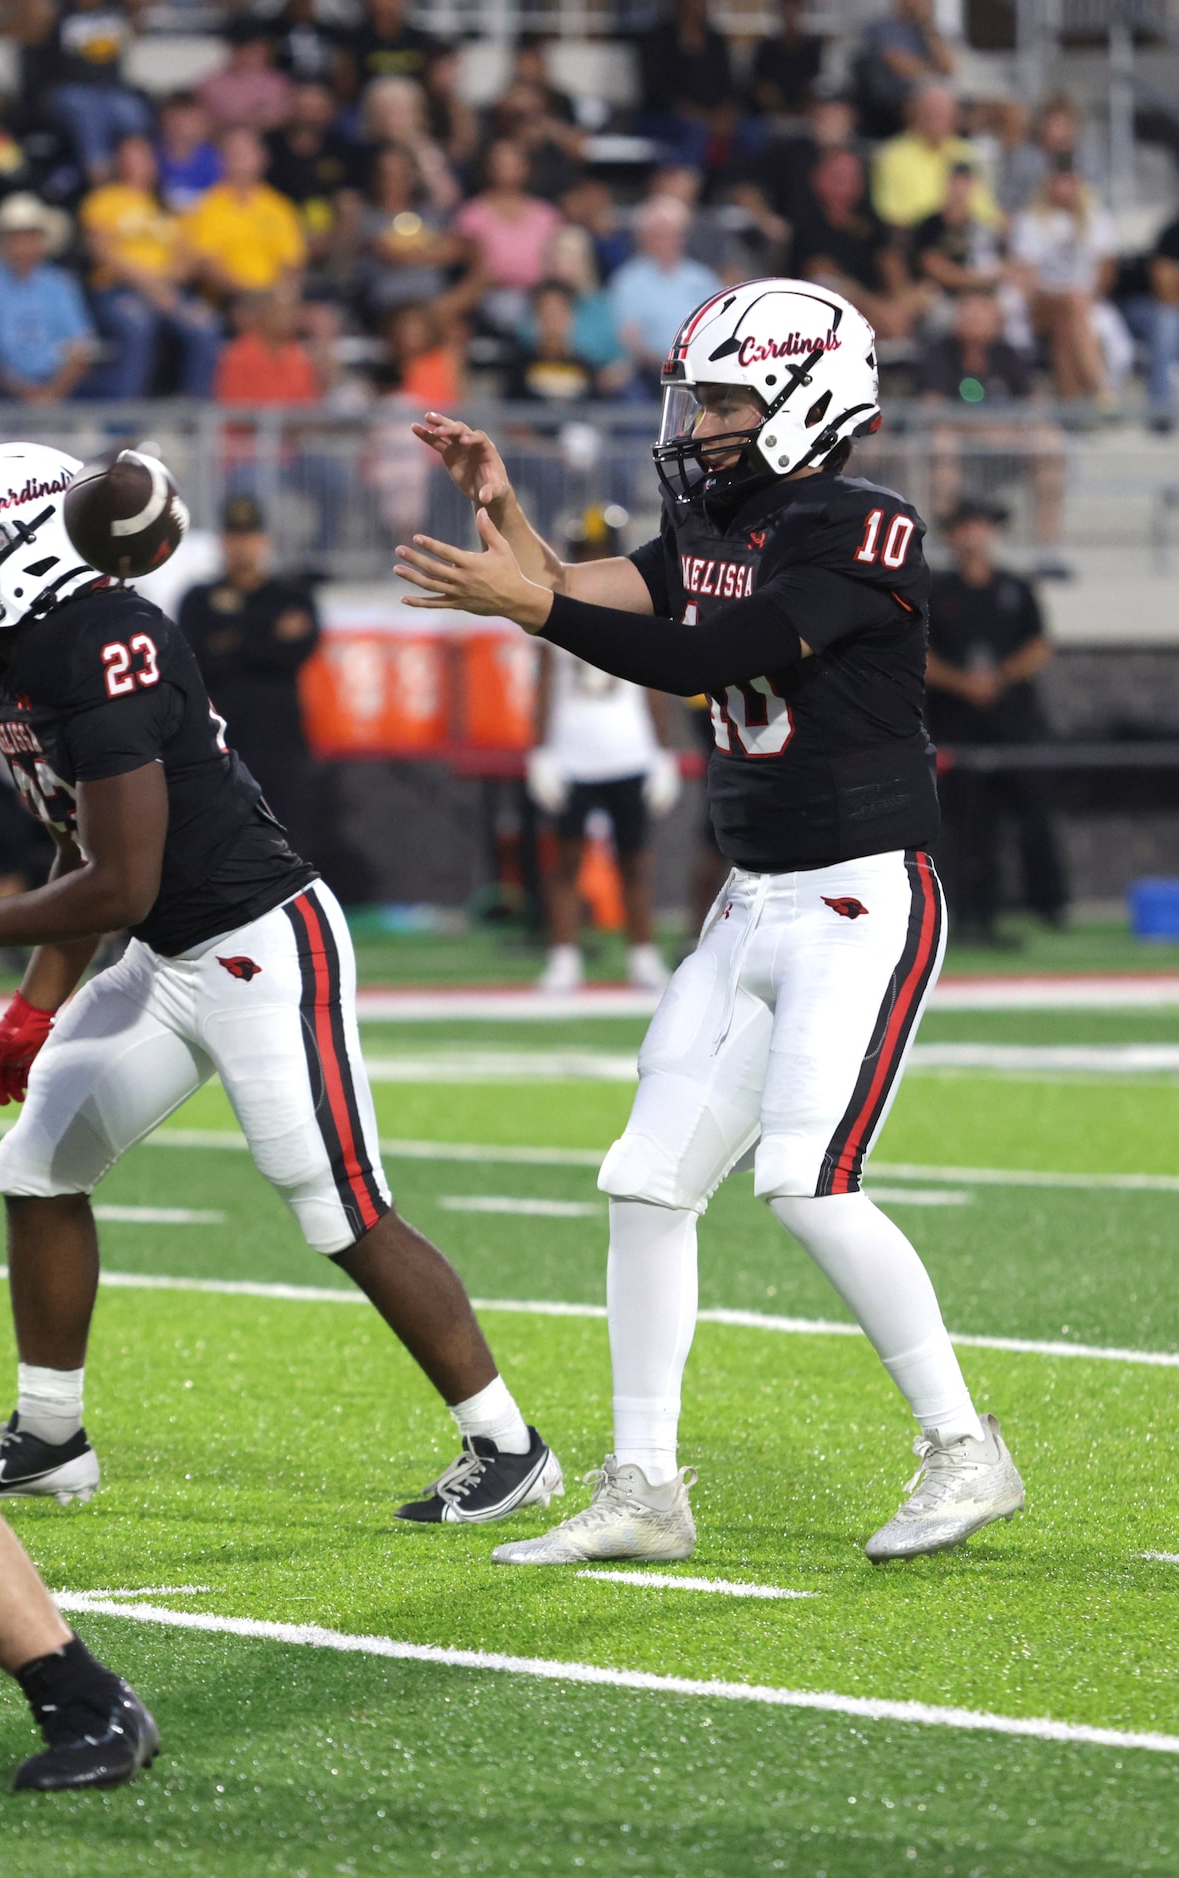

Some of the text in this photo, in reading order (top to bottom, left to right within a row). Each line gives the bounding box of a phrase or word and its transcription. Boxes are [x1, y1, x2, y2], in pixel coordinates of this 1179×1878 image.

[738, 329, 842, 368] Cardinals
[853, 508, 917, 571] 10
[681, 554, 754, 600] MELISSA
[100, 631, 162, 699] 23
